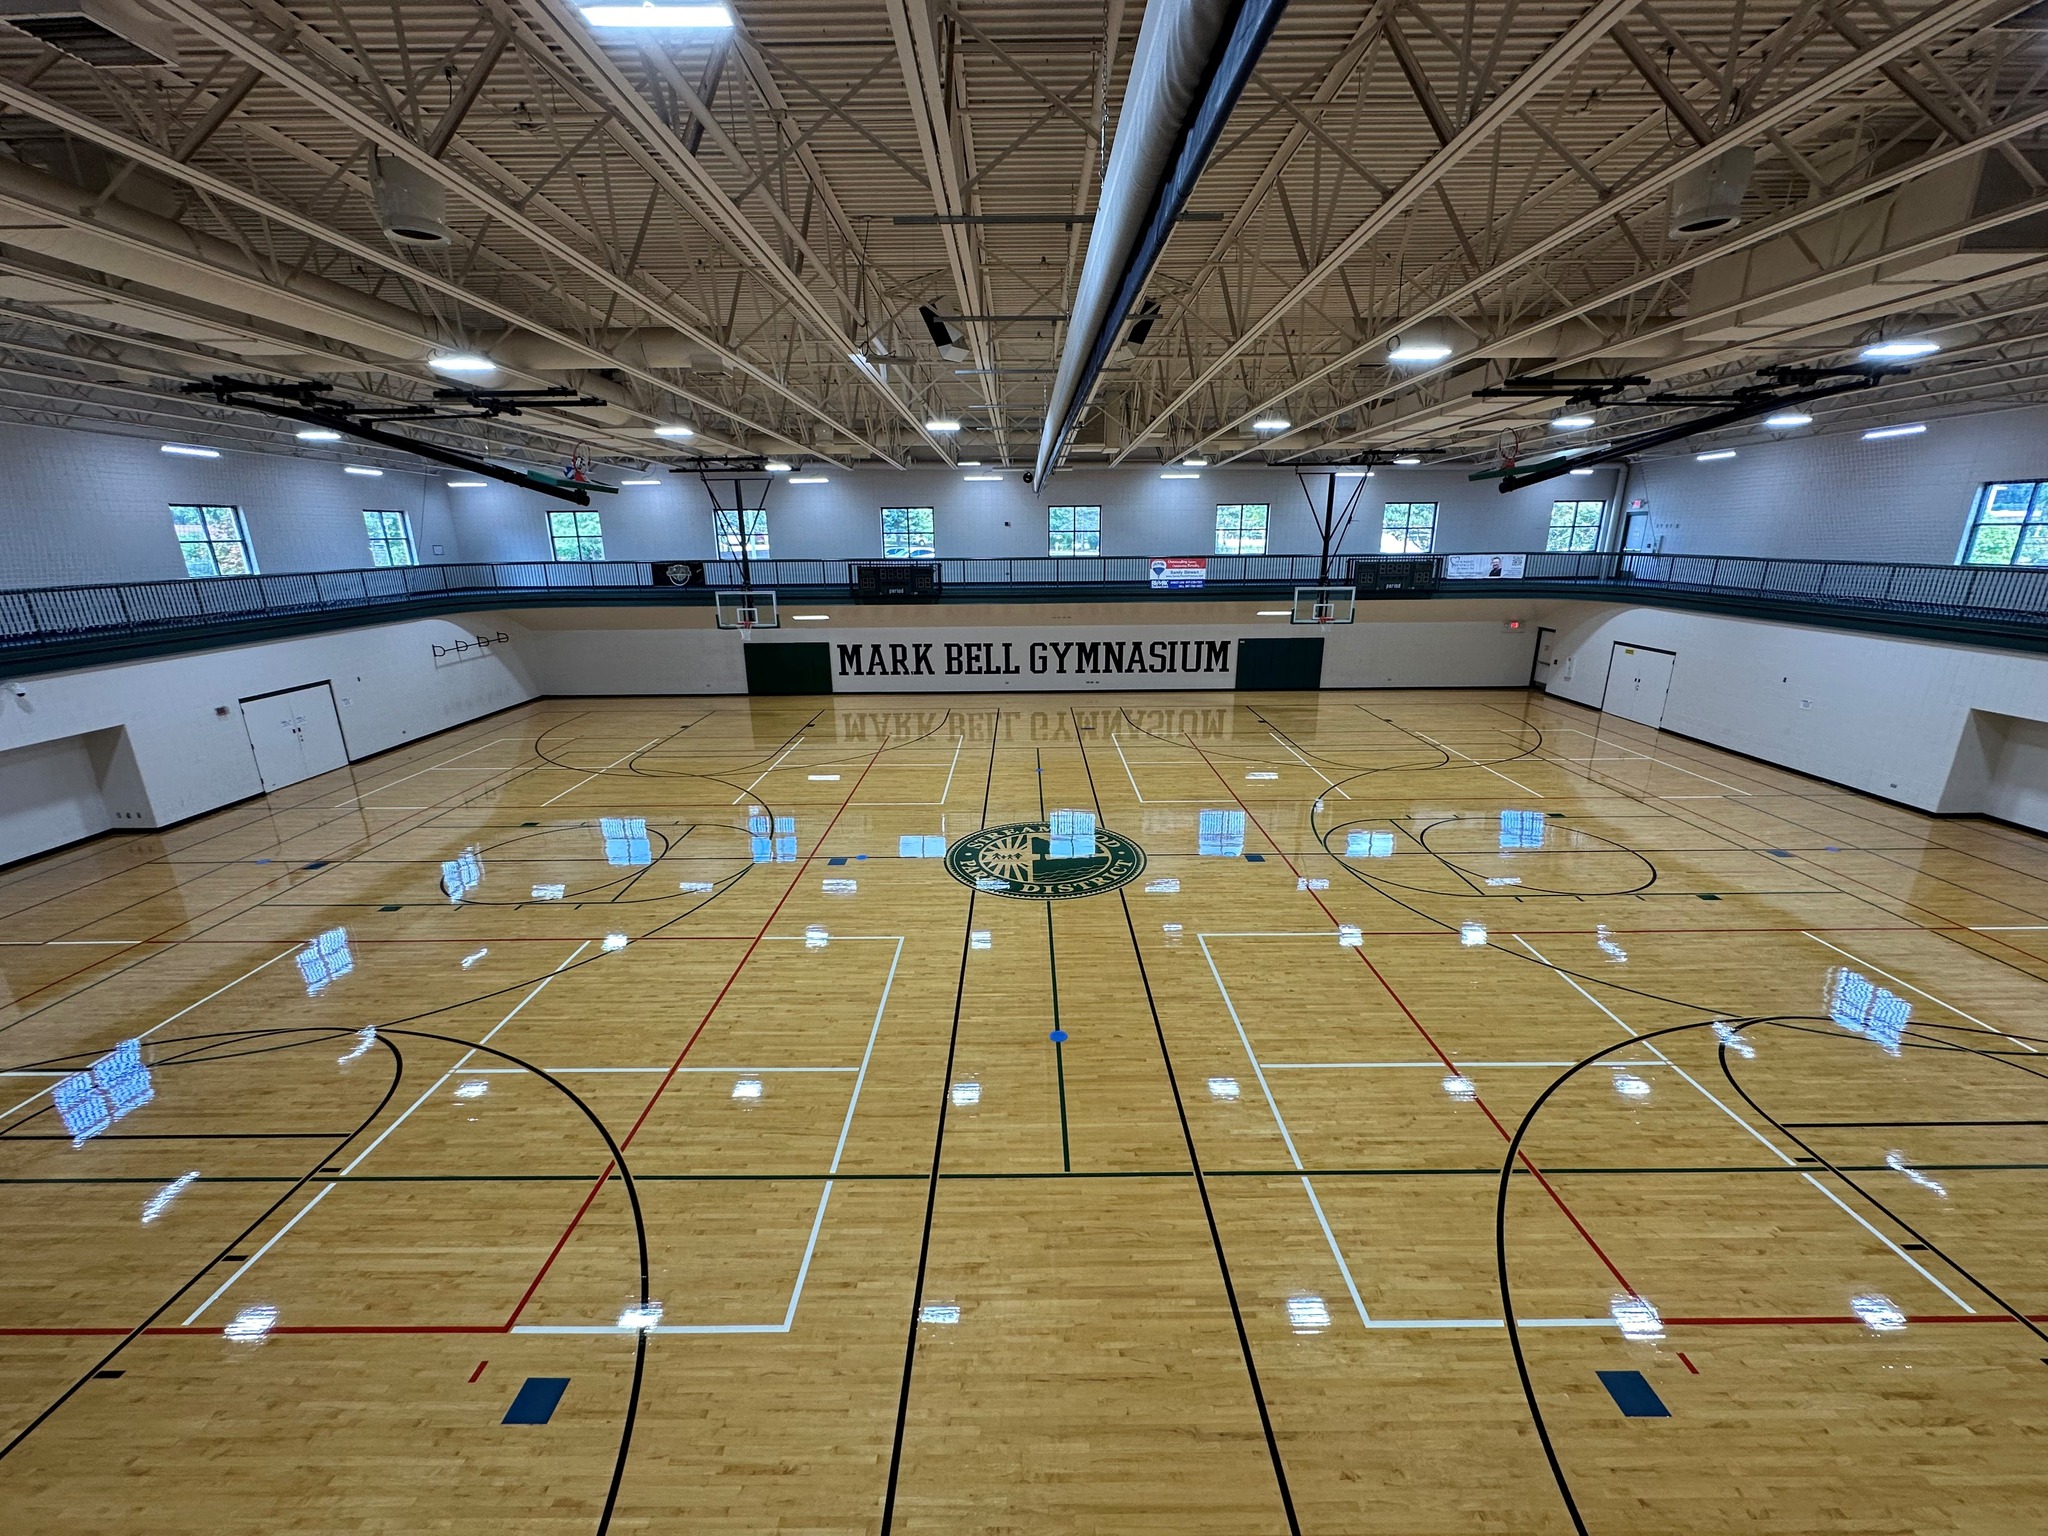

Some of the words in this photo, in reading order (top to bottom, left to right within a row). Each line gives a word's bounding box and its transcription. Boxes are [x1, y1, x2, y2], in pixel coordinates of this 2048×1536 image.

[837, 643, 935, 676] MARK
[944, 642, 1020, 675] BELL
[1029, 640, 1231, 675] GYMNASIUM
[966, 826, 1121, 850] STREAMOD
[1020, 860, 1133, 893] DISTRICT
